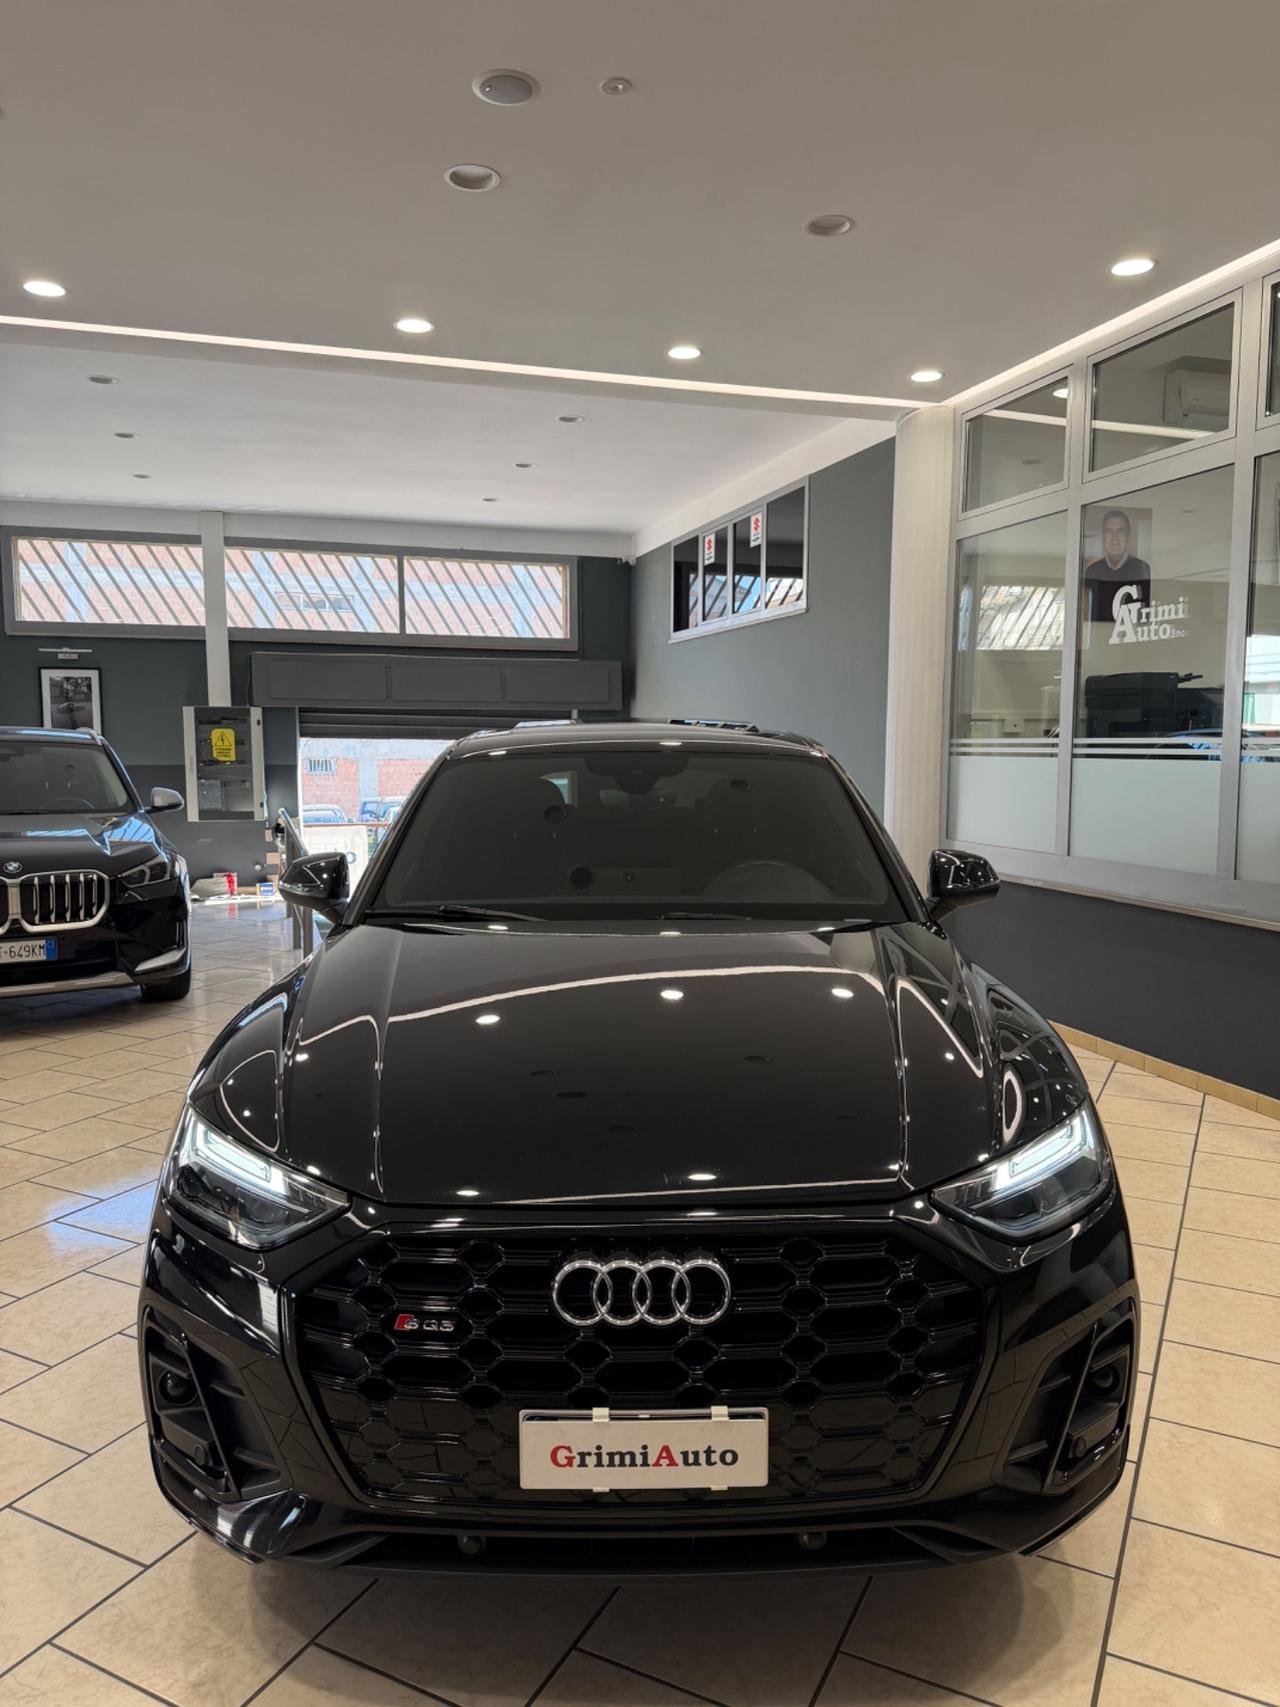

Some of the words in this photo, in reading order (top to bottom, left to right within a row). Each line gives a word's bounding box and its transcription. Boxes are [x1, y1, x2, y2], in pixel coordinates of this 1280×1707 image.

[1112, 584, 1185, 623] Grimi
[1108, 604, 1171, 644] Auto
[550, 1444, 739, 1468] GrimiAuto
